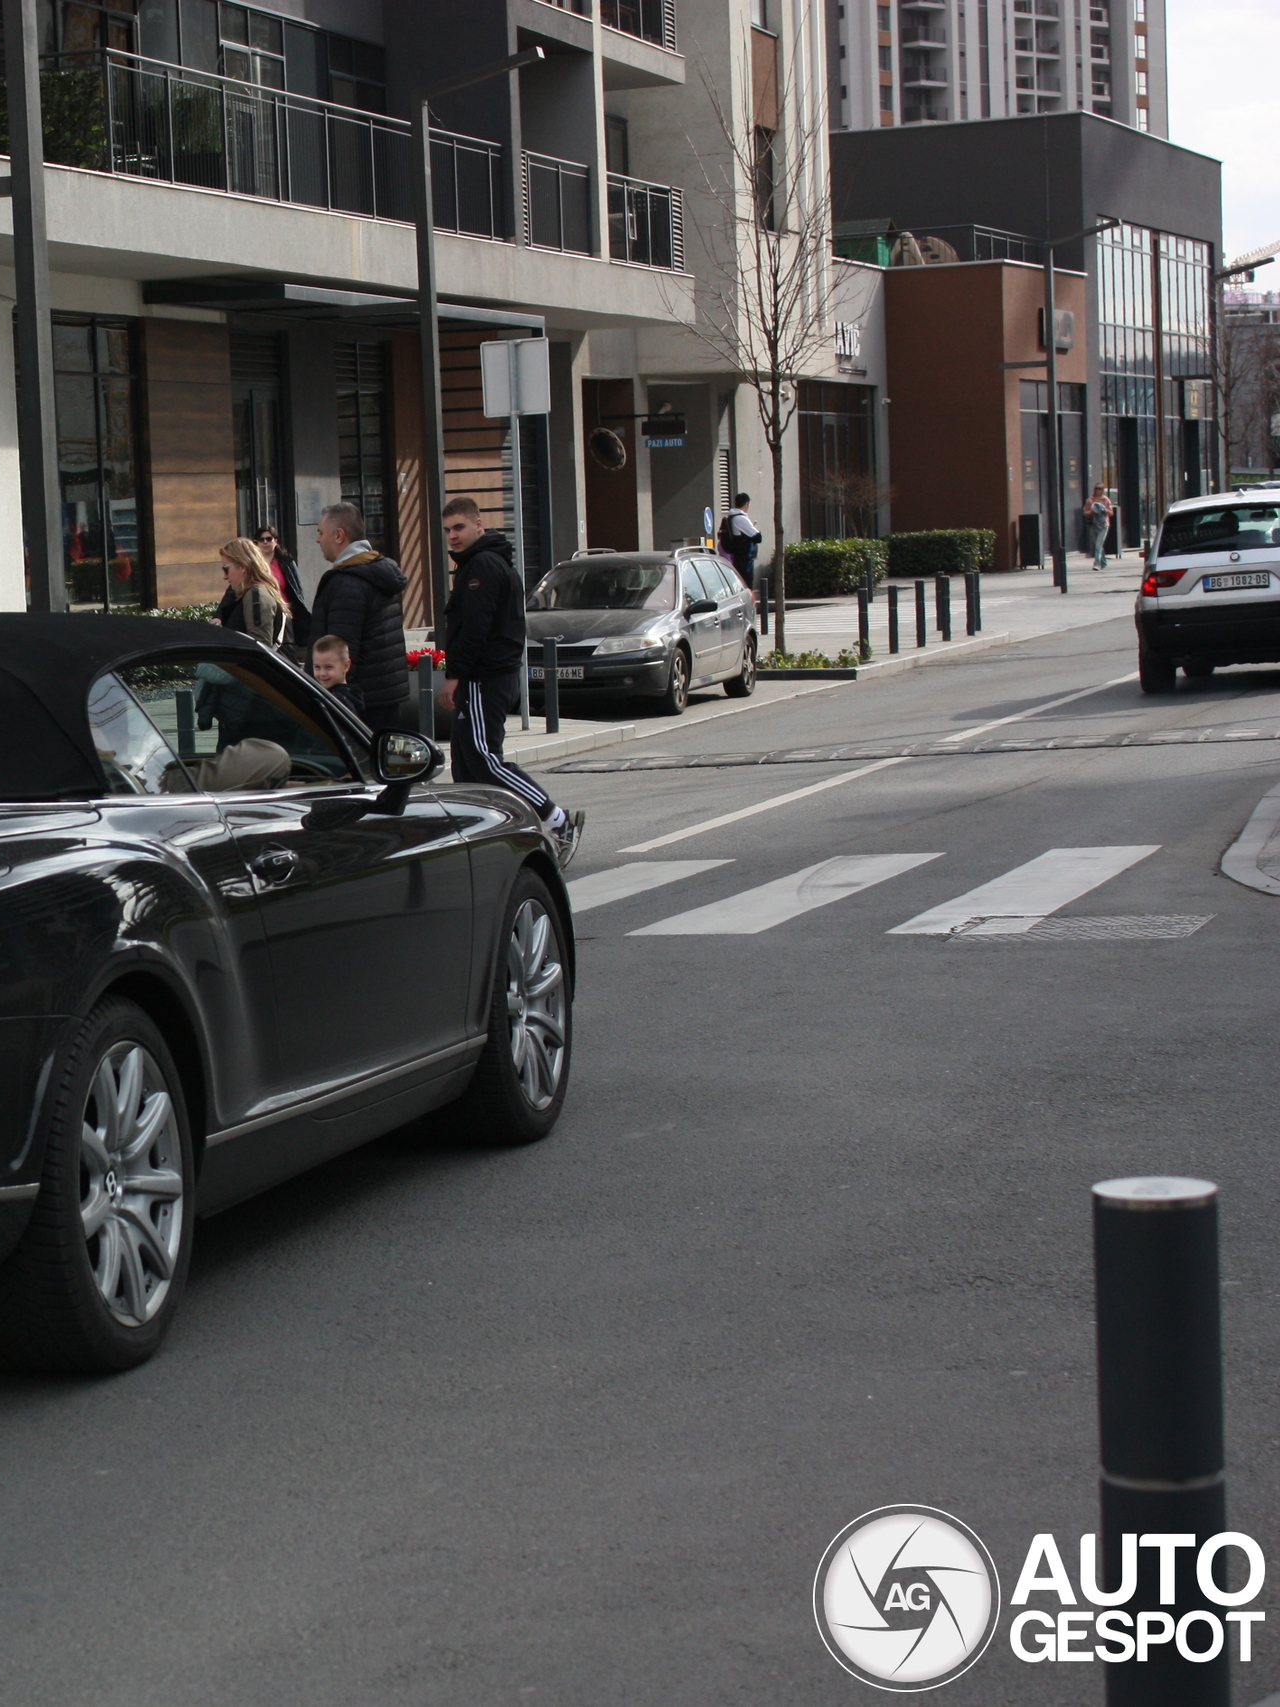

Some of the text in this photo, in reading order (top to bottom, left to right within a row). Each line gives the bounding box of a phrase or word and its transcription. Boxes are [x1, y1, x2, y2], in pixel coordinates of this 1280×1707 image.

[647, 439, 682, 448] PAZI AUTO
[1211, 578, 1222, 588] BG
[532, 668, 543, 678] BG
